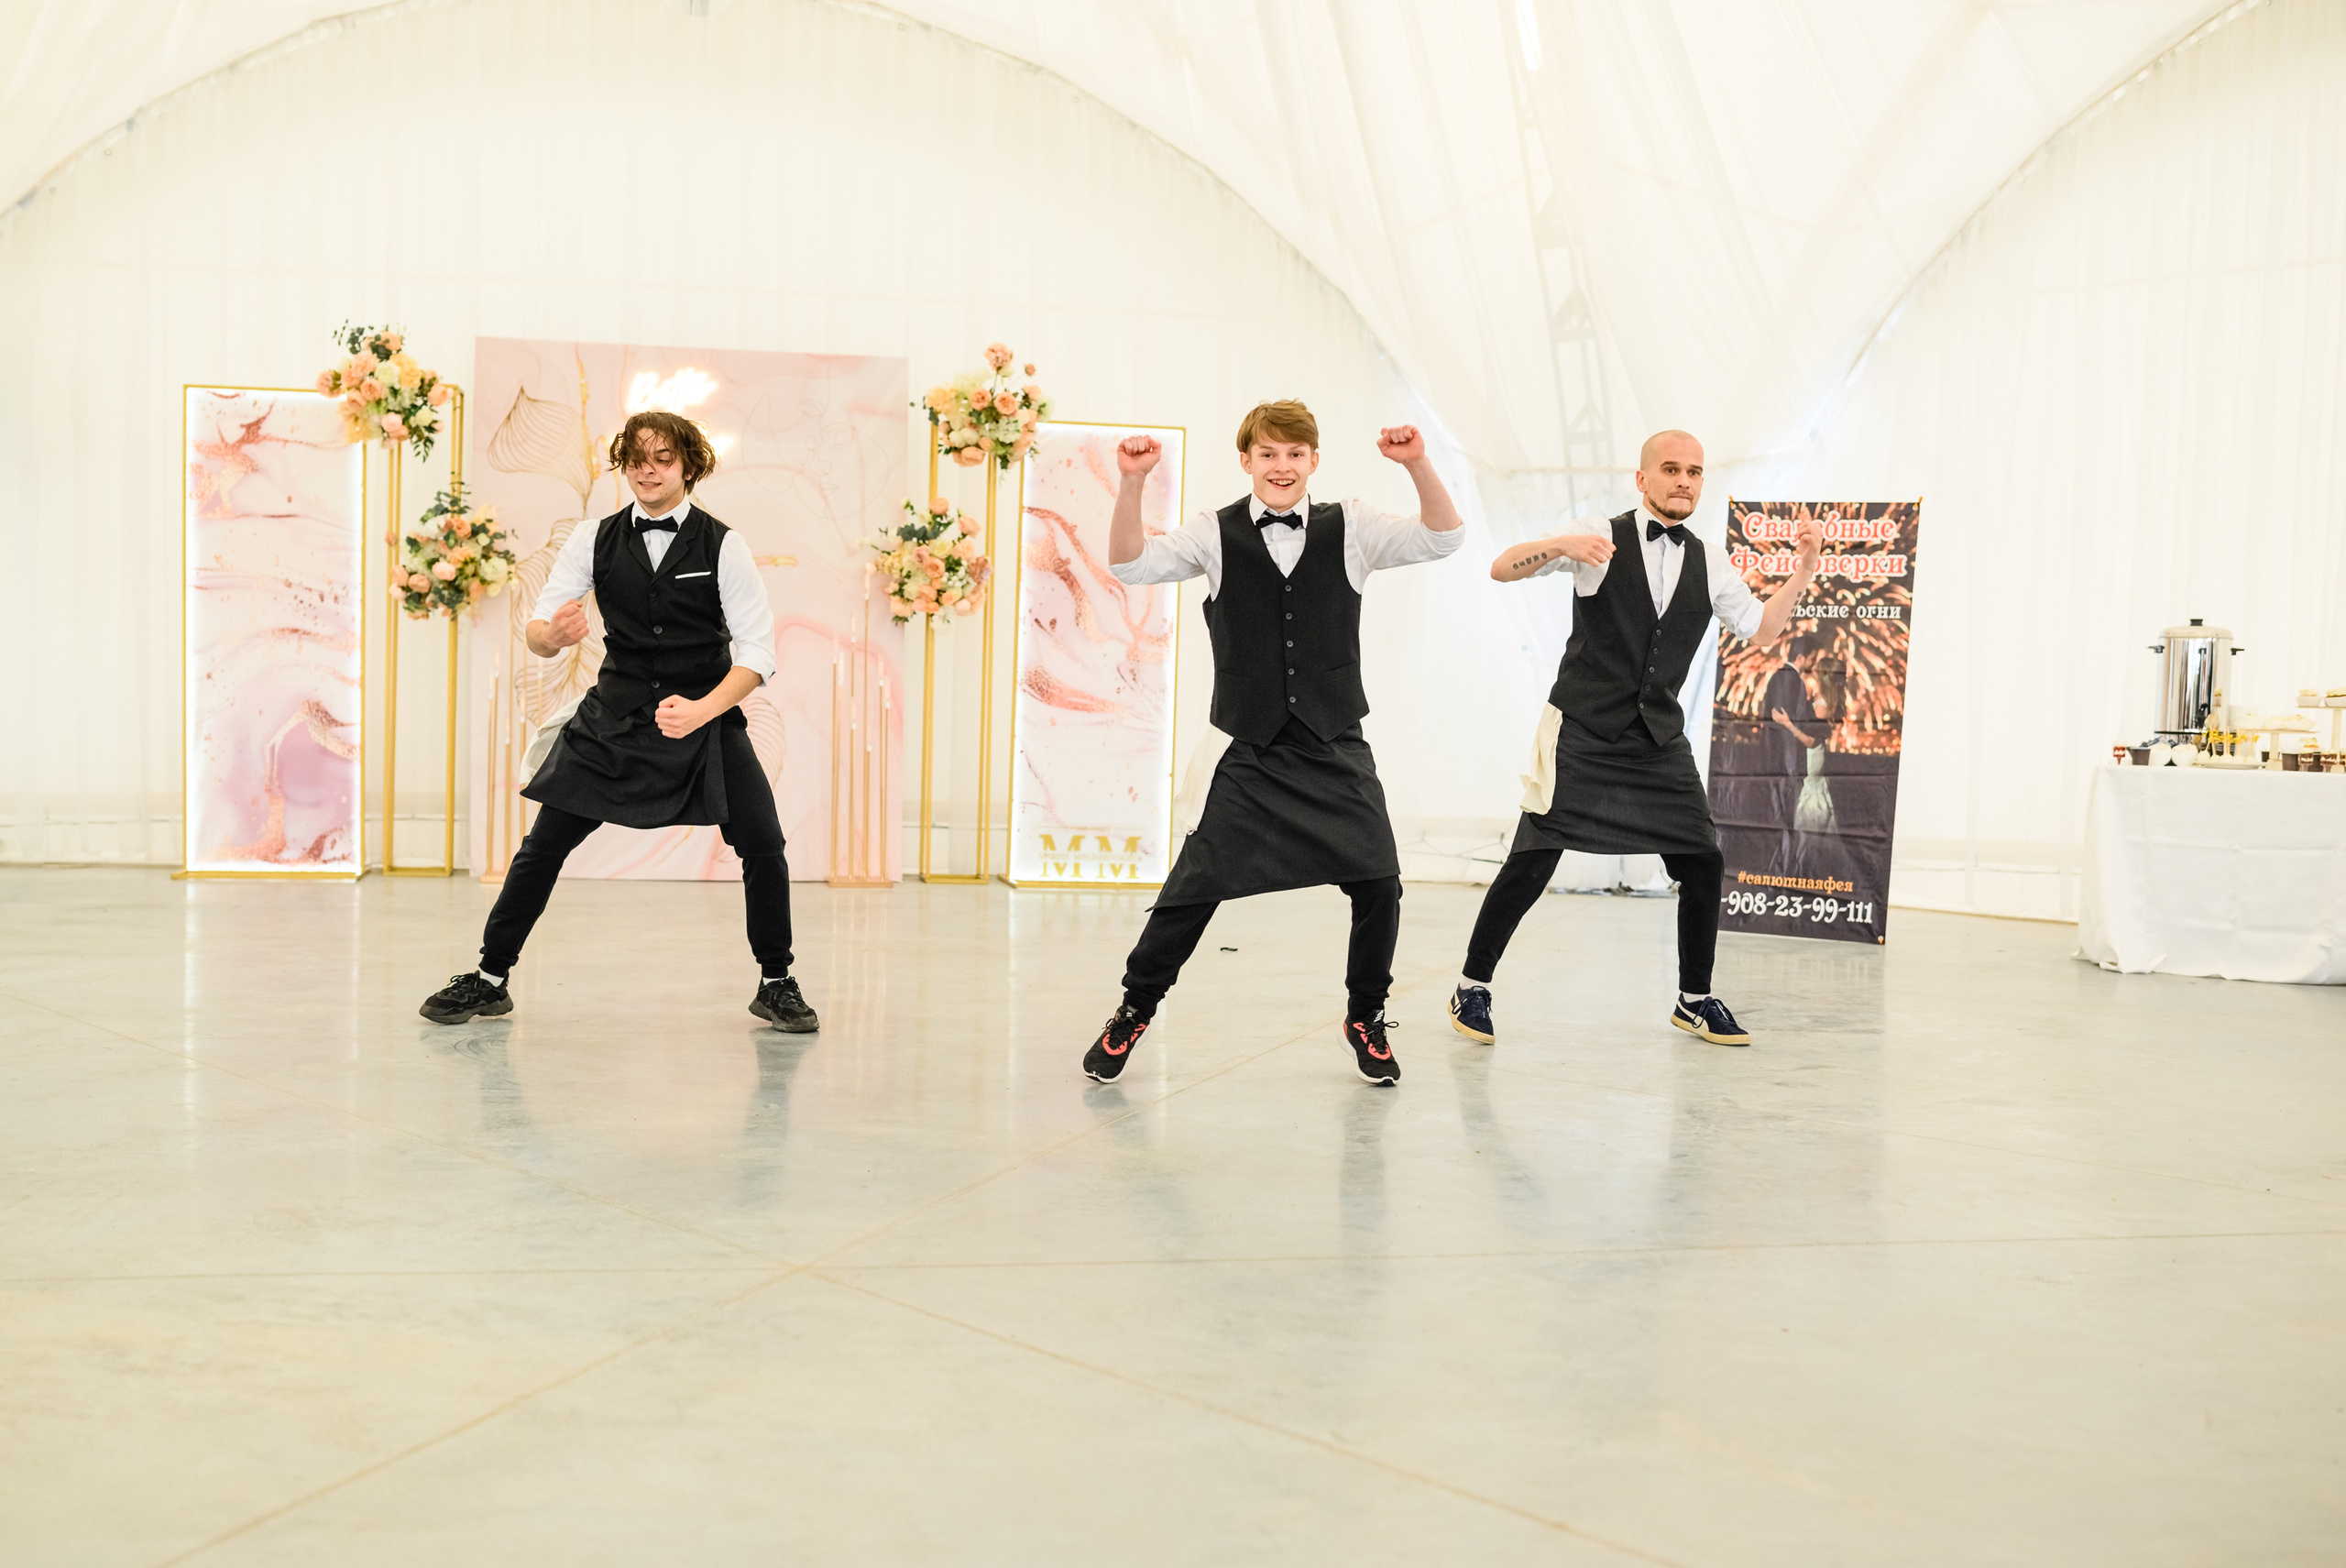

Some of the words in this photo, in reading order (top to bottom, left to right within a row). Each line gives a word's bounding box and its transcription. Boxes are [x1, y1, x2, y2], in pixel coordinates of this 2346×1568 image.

[1744, 511, 1896, 543] Свабные
[1792, 604, 1849, 619] ьские
[1856, 605, 1902, 620] огни
[1738, 871, 1853, 894] #салютнаяфея
